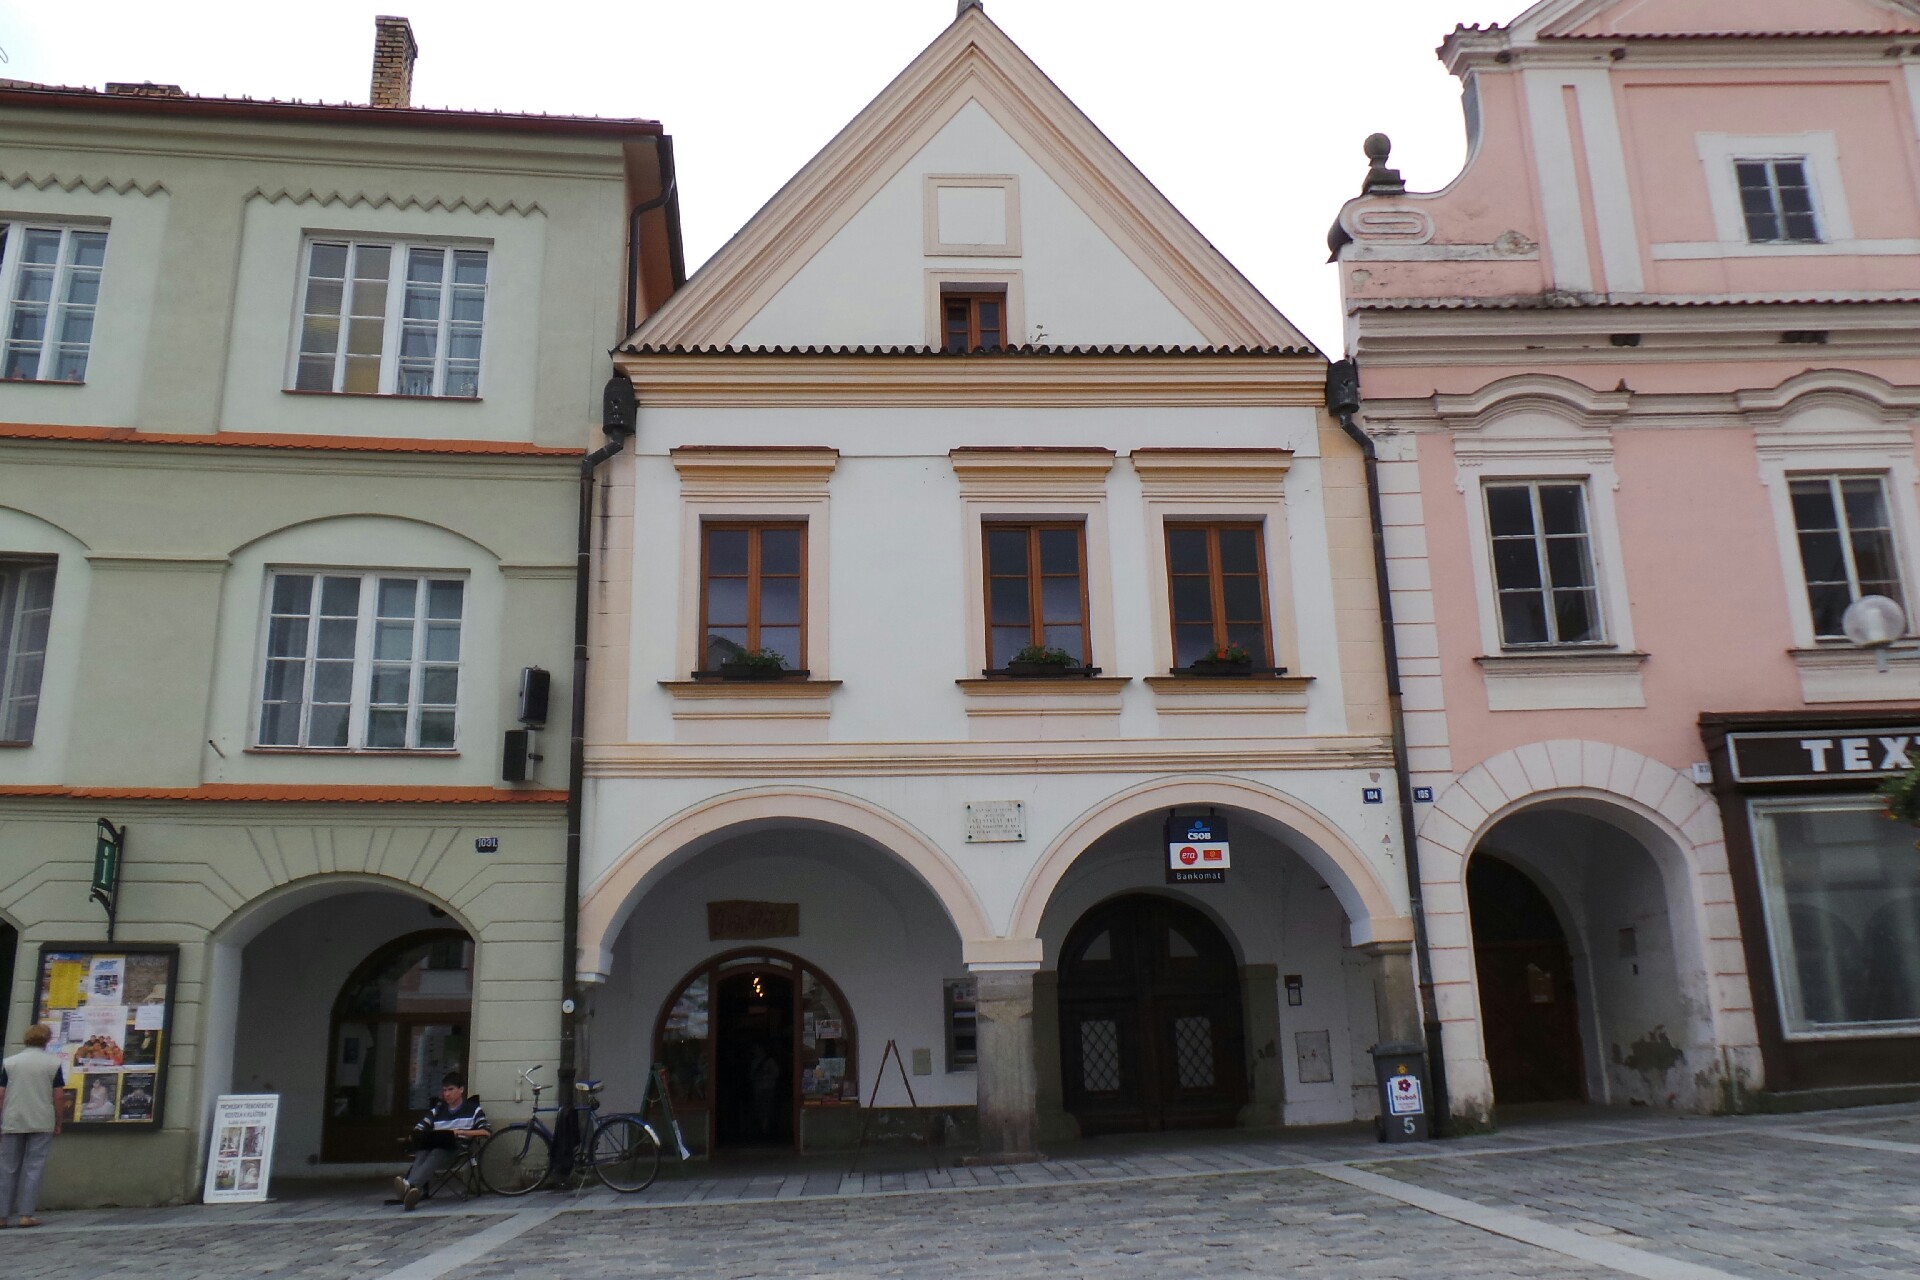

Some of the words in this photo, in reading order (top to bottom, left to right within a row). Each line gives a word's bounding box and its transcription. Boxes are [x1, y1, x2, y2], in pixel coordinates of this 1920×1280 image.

[1801, 736, 1920, 772] TEX
[1366, 790, 1379, 800] 104
[1417, 790, 1430, 799] 105
[1176, 872, 1221, 880] Bankomat
[1404, 1116, 1415, 1134] 5
